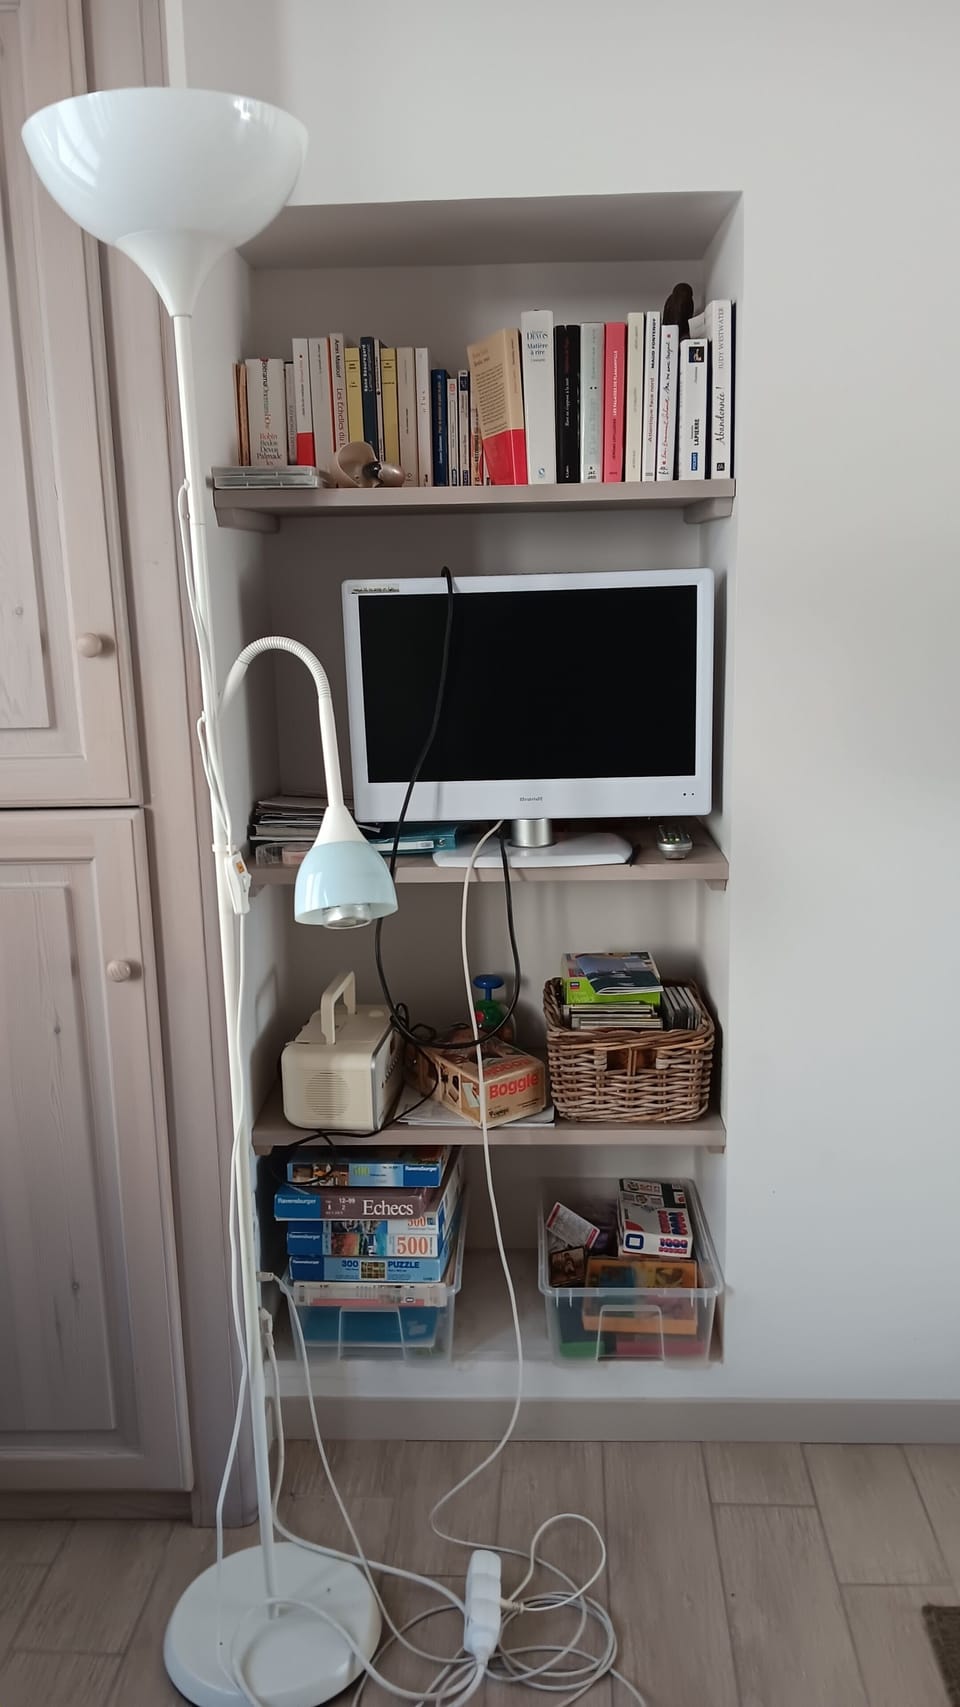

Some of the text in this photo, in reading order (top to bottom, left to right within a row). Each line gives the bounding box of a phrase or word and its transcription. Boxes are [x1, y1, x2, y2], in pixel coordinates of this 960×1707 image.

[692, 418, 700, 447] LAPIERRE
[488, 1072, 539, 1100] Boggle
[362, 1199, 414, 1216] Echecs
[397, 1235, 429, 1255] 500
[660, 1238, 688, 1248] 1000
[341, 1260, 359, 1268] 300
[387, 1260, 420, 1269] PUZZLE
